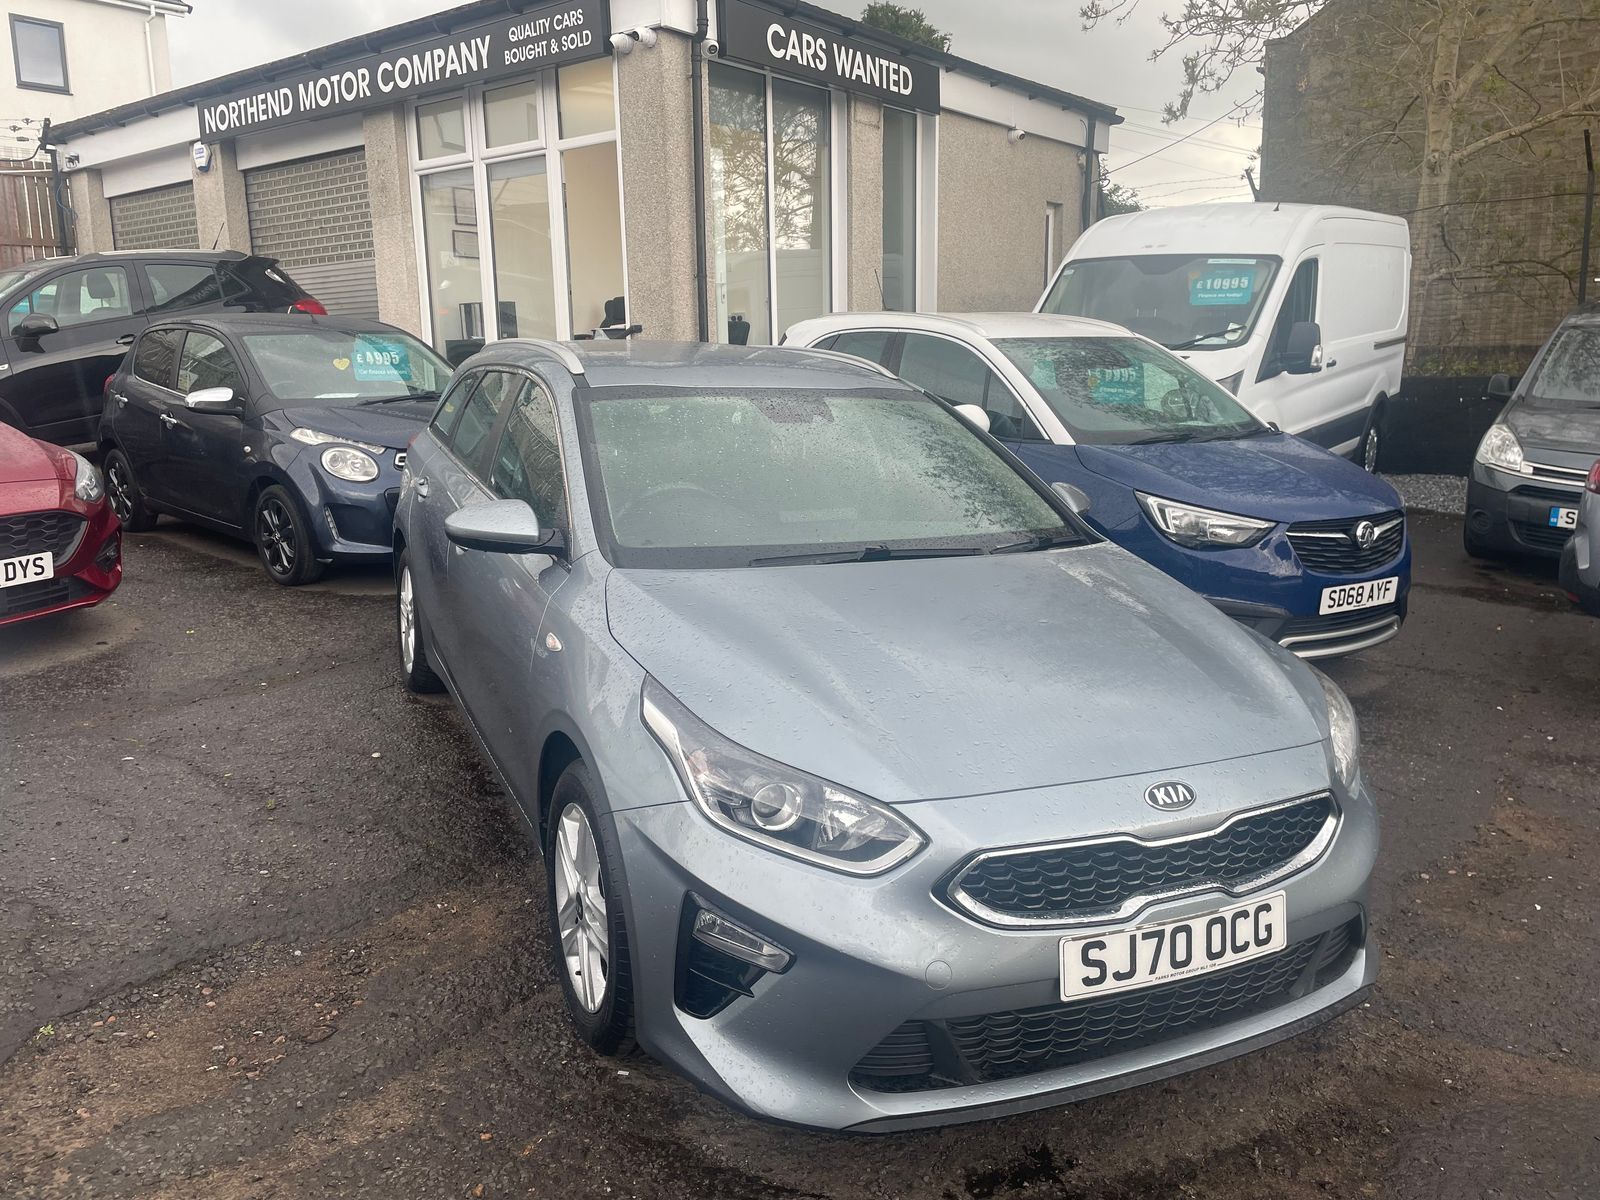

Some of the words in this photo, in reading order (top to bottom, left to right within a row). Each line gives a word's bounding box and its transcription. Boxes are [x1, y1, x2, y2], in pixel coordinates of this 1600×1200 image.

[508, 17, 551, 42] QUALITY
[553, 8, 584, 31] CARS
[504, 40, 548, 65] BOUGHT
[550, 38, 559, 55] &
[561, 29, 592, 52] SOLD
[766, 23, 828, 71] CARS
[832, 42, 913, 96] WANTED
[203, 87, 294, 134] NORTHEND
[298, 67, 371, 112] MOTOR
[377, 34, 491, 93] COMPANY
[4, 556, 45, 582] DYS
[1327, 585, 1365, 609] SD68
[1366, 580, 1393, 603] AYF
[1151, 784, 1192, 805] KIA
[1081, 924, 1193, 987] SJ70
[1205, 902, 1272, 961] OCG
[1170, 970, 1185, 978] MOTOR
[1185, 967, 1200, 975] GROUP
